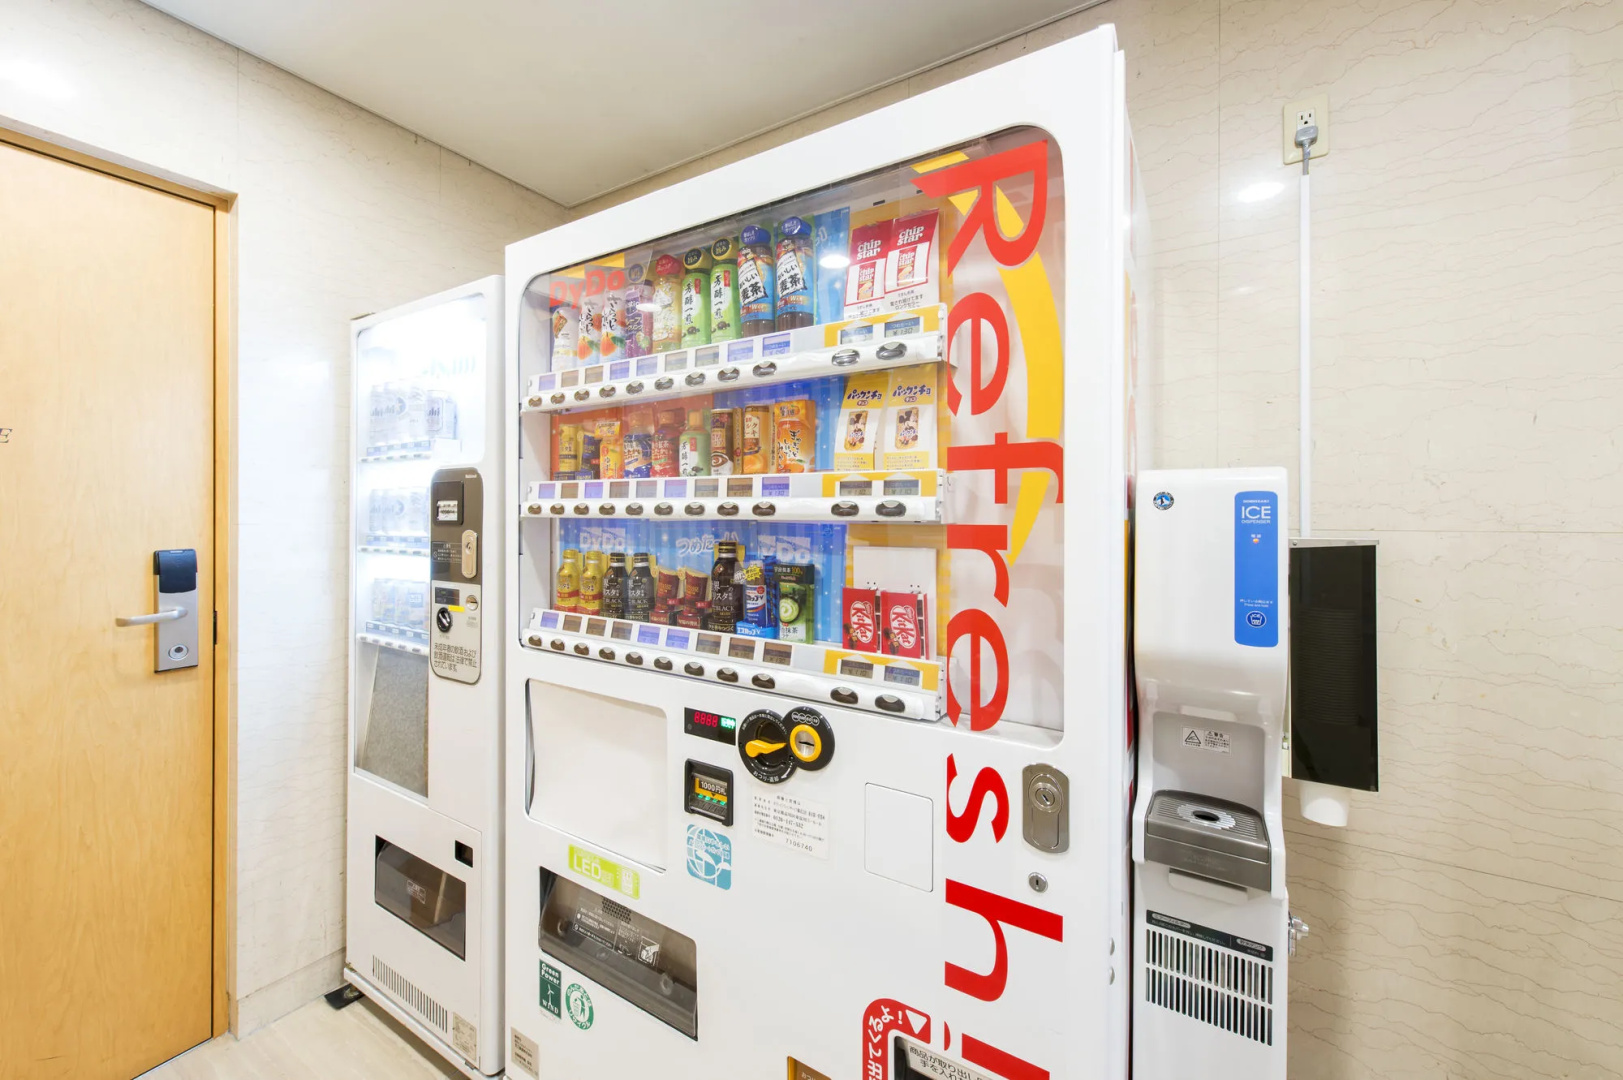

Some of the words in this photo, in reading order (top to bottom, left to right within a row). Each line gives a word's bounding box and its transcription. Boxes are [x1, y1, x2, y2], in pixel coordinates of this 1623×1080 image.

[897, 232, 923, 246] star
[899, 225, 925, 238] chip
[857, 239, 881, 252] chip
[857, 246, 880, 260] star
[549, 269, 626, 309] DyDo
[780, 272, 801, 293] 麦茶
[1241, 505, 1271, 519] ICE
[574, 854, 602, 880] LED
[541, 963, 559, 978] Green
[541, 969, 560, 985] Power
[542, 998, 559, 1014] WIND
